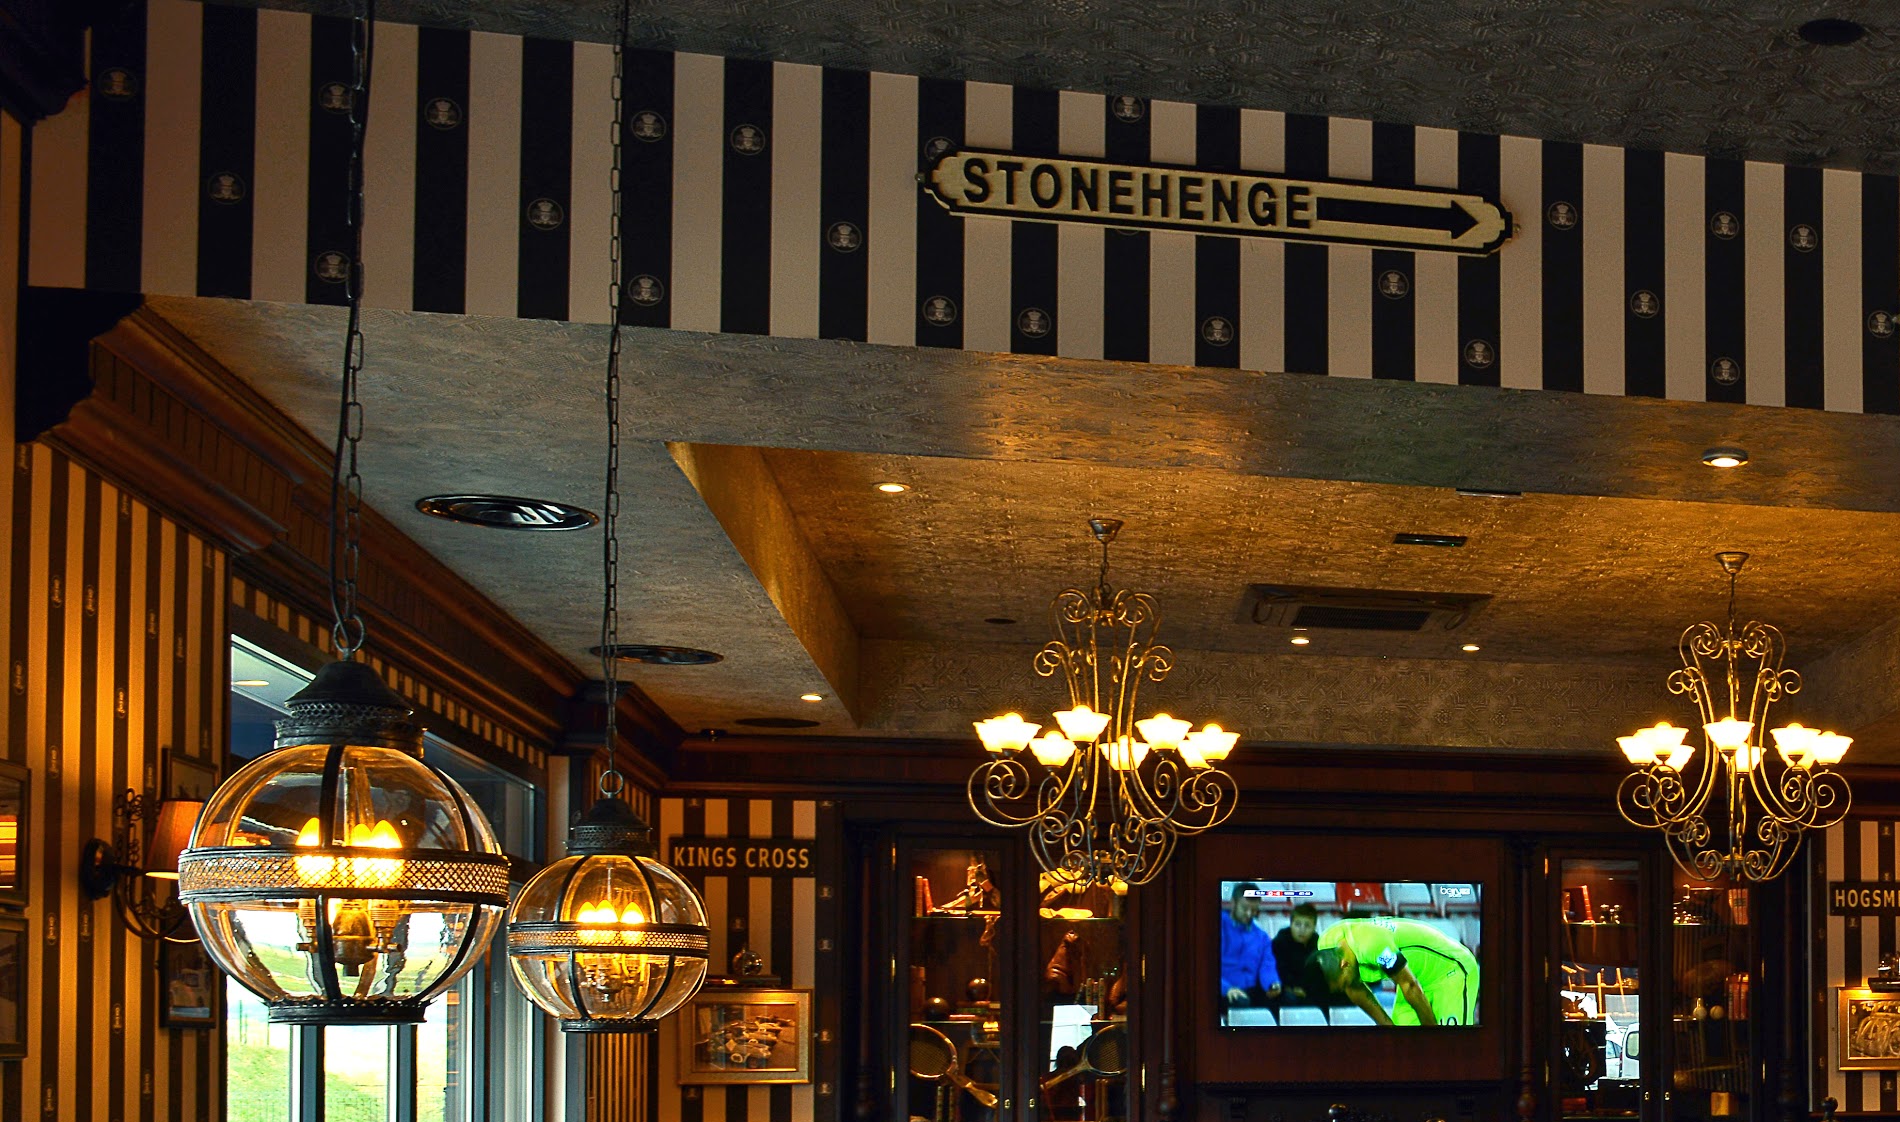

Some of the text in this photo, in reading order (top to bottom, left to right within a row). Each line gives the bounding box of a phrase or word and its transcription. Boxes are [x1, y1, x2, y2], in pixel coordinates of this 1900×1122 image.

[961, 157, 1313, 229] STONEHENGE
[674, 847, 810, 869] KINGS CROSS
